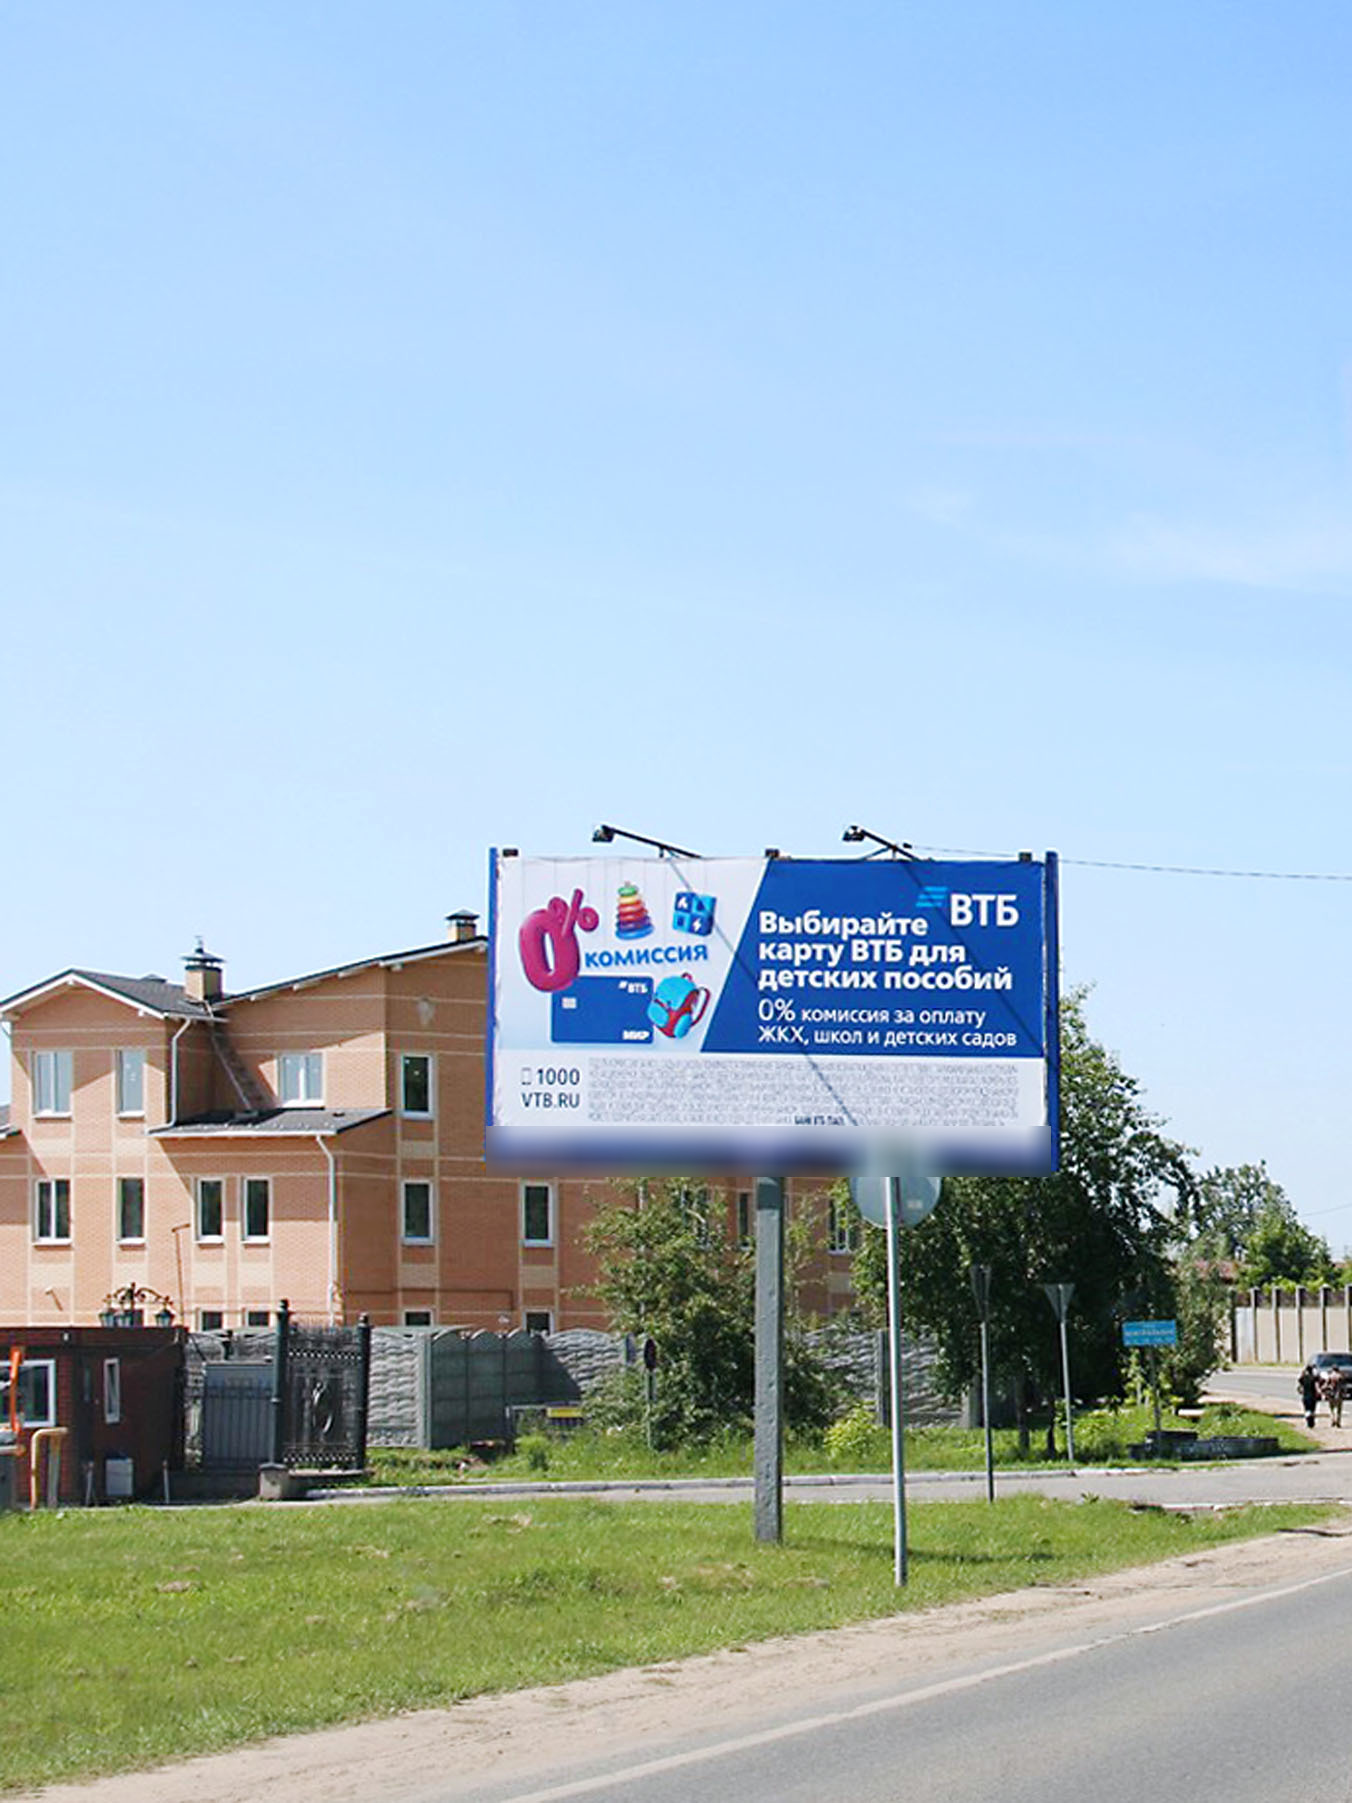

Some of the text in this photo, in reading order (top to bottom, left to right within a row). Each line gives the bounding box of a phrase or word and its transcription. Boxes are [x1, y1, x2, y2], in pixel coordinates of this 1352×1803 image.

[951, 894, 1019, 926] ВТБ
[759, 910, 928, 940] Выбирайте
[519, 888, 600, 993] 0%
[759, 940, 965, 967] карту ВТБ для
[759, 965, 1012, 991] детских пособий
[758, 998, 986, 1028] 0% комиссия за оплату
[758, 1026, 1017, 1047] ЖКХ, школ и детских садов
[536, 1068, 580, 1086] 1000
[521, 1092, 581, 1108] VTB.RU
